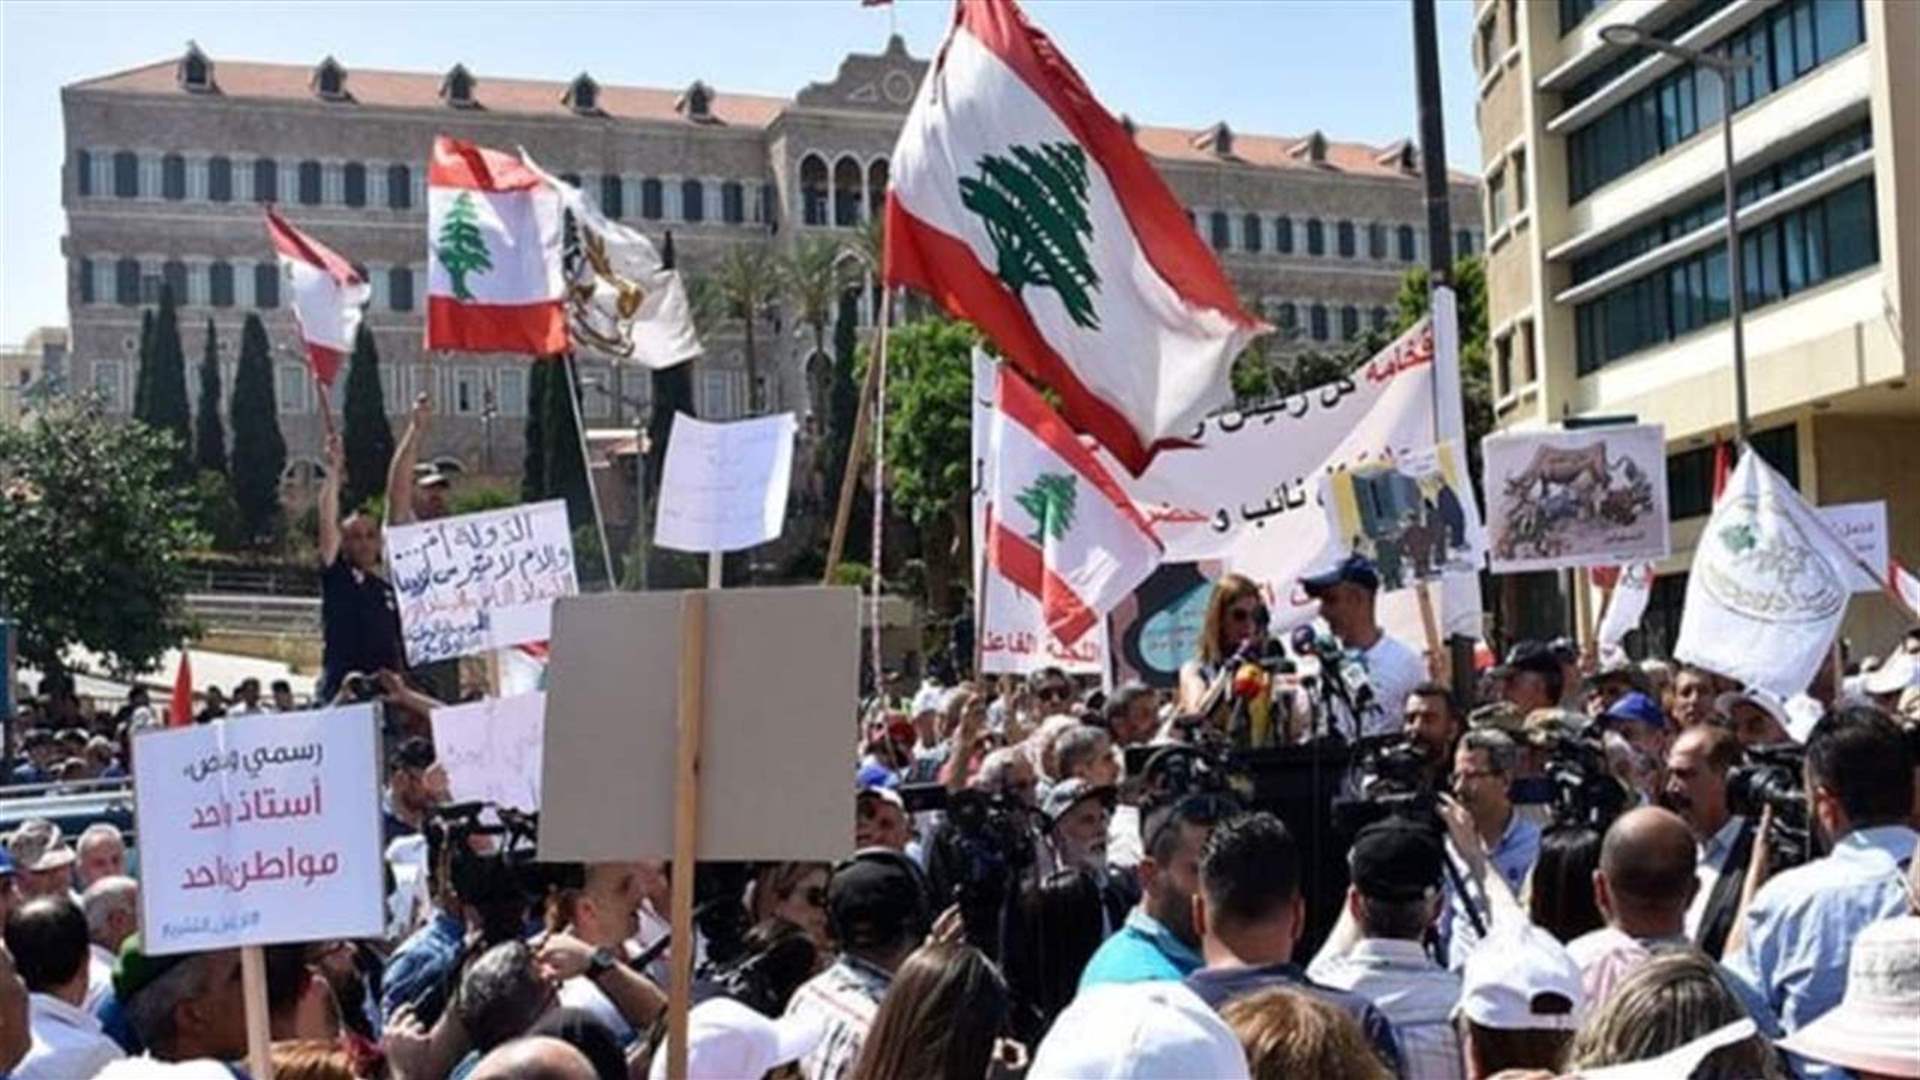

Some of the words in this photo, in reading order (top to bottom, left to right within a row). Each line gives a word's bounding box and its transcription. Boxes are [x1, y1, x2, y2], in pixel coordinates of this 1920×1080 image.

[242, 743, 322, 780] رسمي
[236, 775, 321, 823] أستاذ
[227, 846, 339, 893] مواطن
